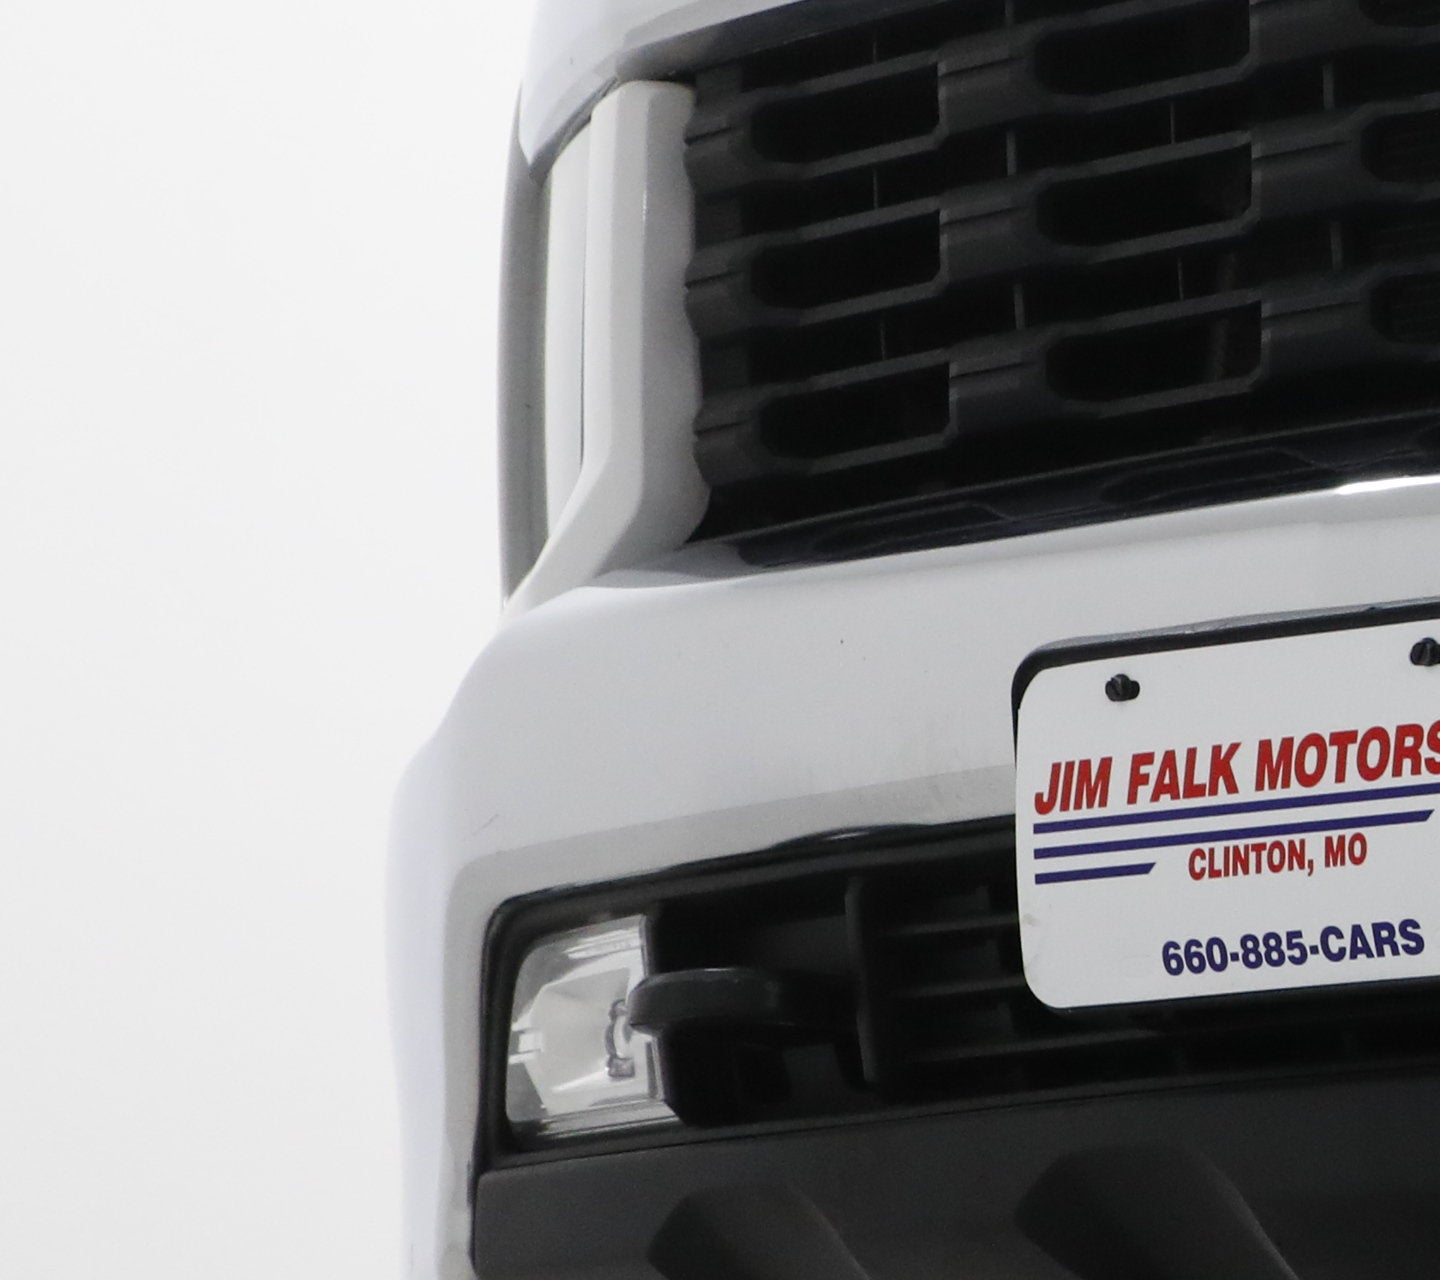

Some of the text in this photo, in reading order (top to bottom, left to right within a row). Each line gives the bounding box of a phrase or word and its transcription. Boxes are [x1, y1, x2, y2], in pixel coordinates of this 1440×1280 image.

[1034, 756, 1113, 816] JIM
[1126, 742, 1241, 805] FALK
[1188, 832, 1368, 881] CLINTON, MO
[1162, 919, 1425, 976] 660-885-CARS
